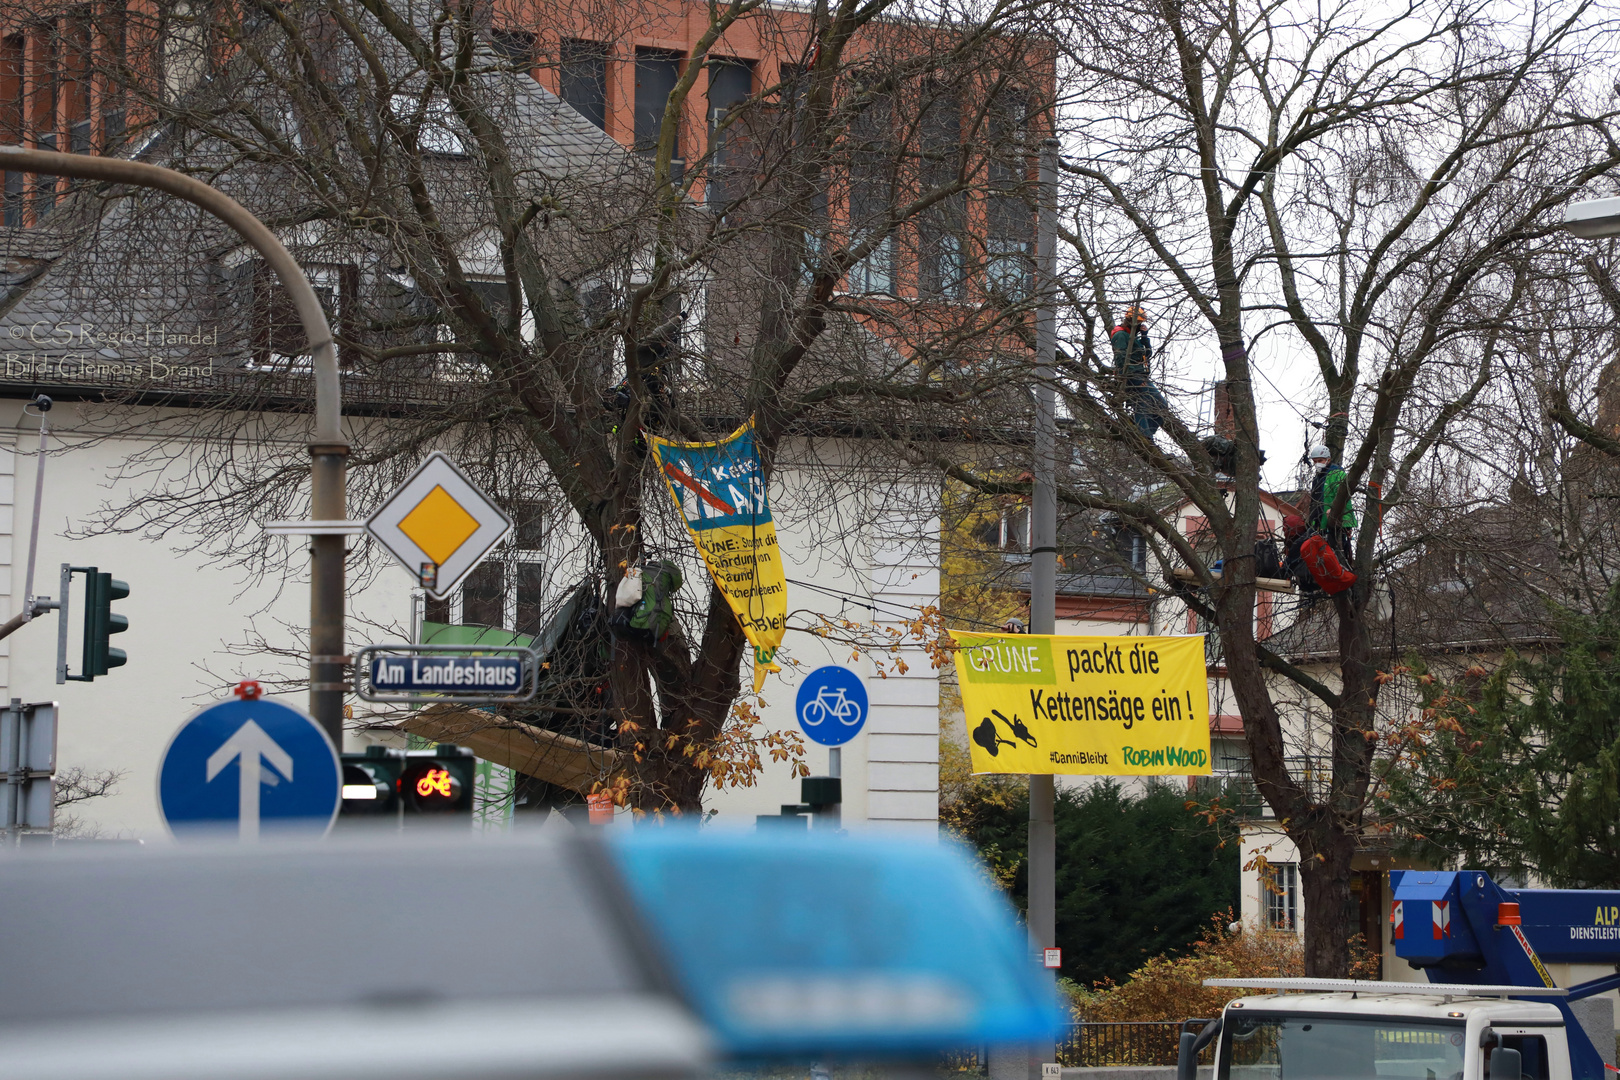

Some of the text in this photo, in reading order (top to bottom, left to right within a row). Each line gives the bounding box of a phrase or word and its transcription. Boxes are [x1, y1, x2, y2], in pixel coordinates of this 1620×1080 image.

[376, 659, 517, 686] Am Landeshaus
[969, 639, 1159, 682] GRÜNE packt die
[1030, 688, 1145, 730] Kettensäge
[1152, 688, 1182, 721] ein
[1050, 751, 1109, 765] #DanniBleibt
[1594, 906, 1620, 926] ALP
